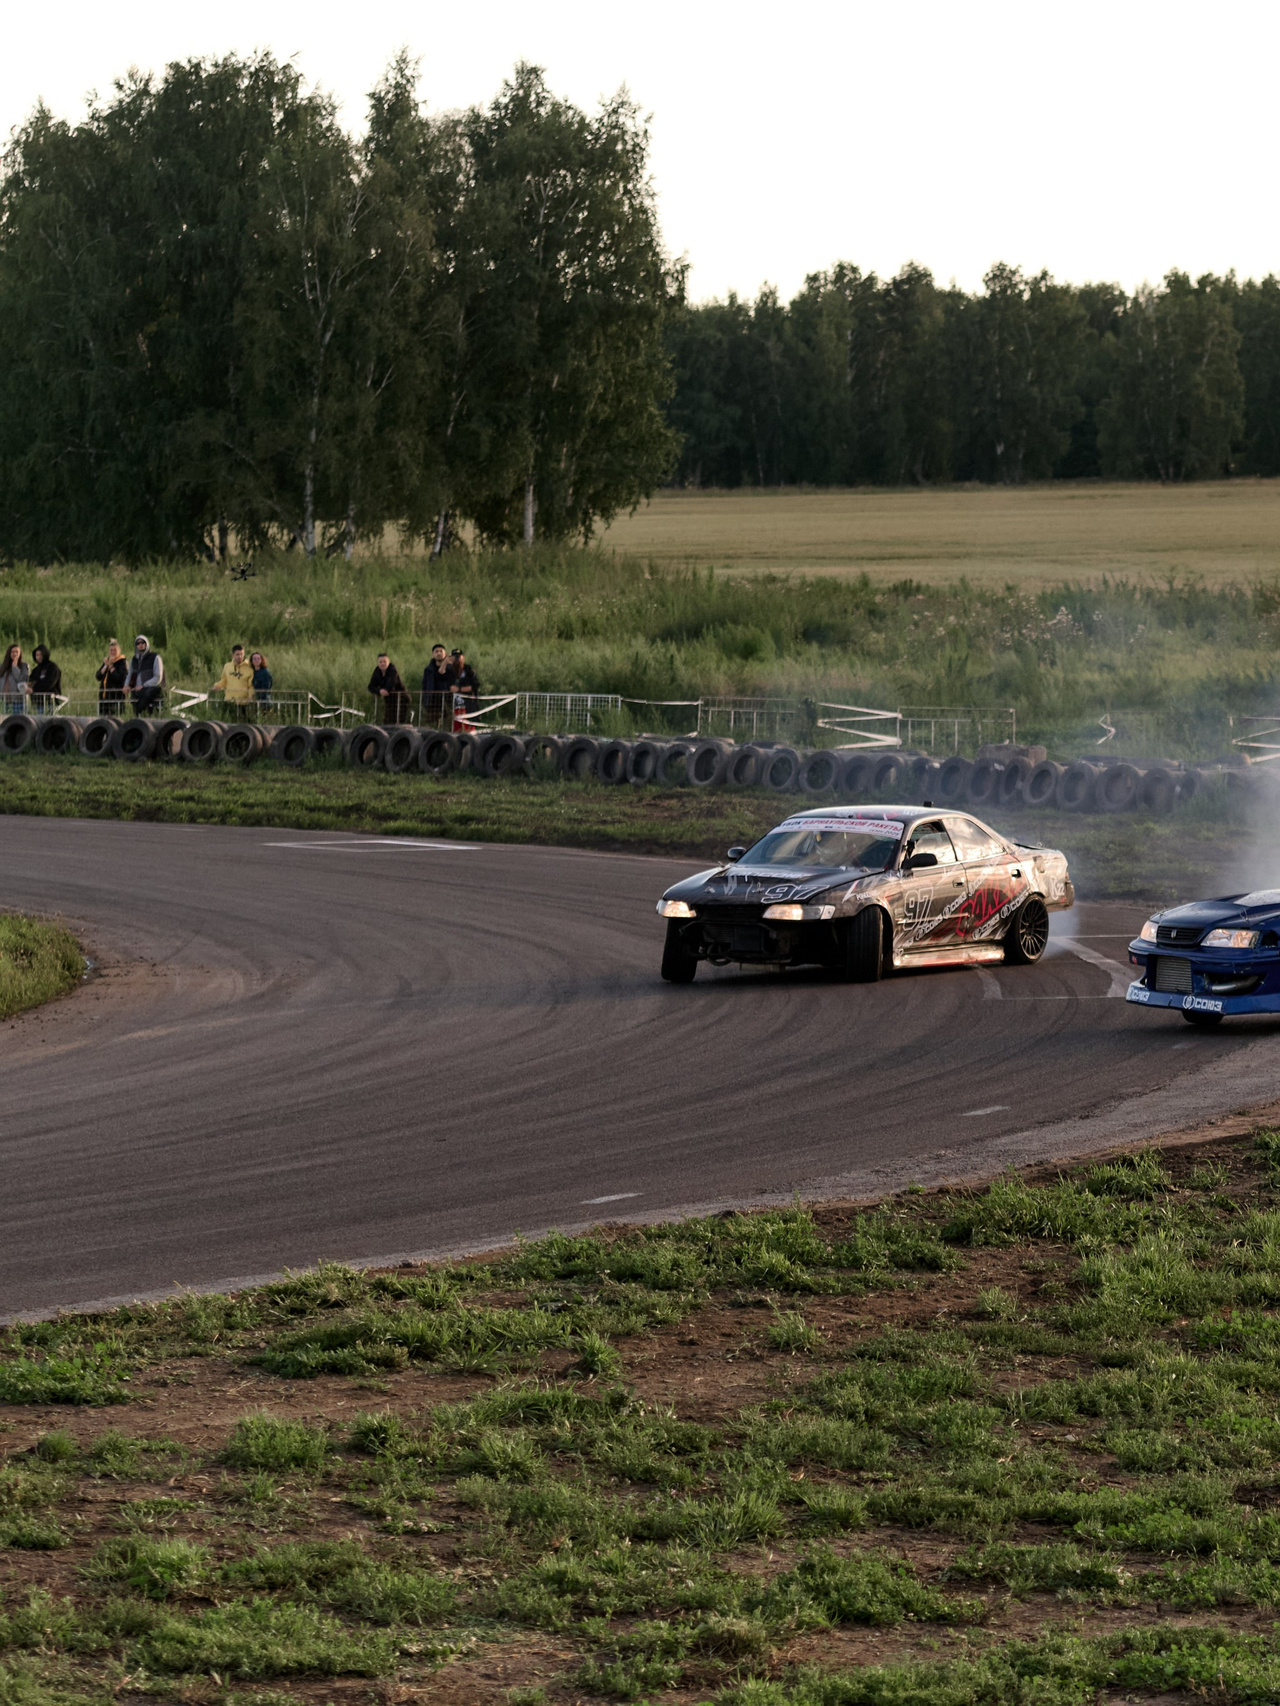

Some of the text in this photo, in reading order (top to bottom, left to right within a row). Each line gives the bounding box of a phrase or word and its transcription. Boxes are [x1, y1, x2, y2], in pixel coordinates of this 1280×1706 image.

[867, 822, 903, 832] РАКЕТЫ
[761, 884, 830, 904] 97
[903, 887, 934, 931] 97
[1195, 998, 1223, 1012] СОЮЗ
